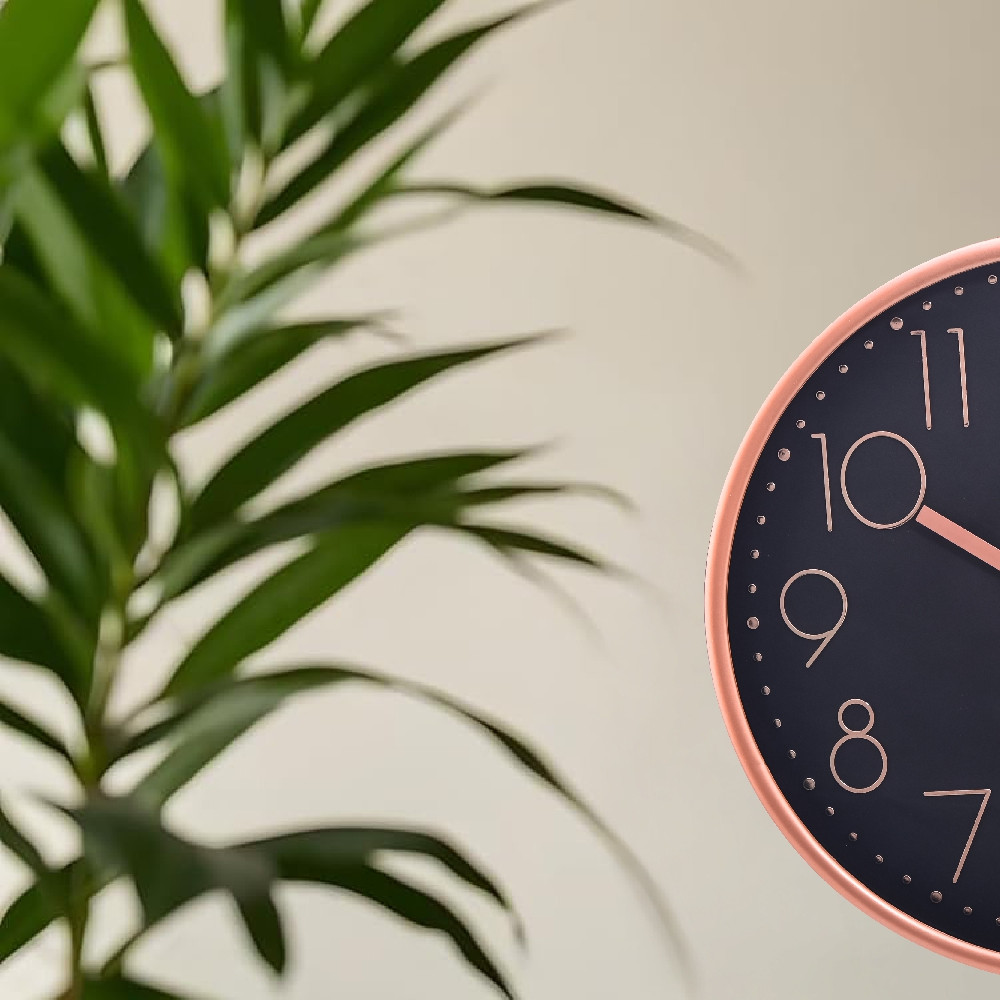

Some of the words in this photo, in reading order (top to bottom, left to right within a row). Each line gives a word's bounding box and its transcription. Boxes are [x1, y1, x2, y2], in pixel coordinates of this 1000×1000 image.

[911, 327, 970, 430] 11
[811, 430, 927, 532] 10
[780, 568, 848, 668] 9
[829, 699, 888, 793] 8
[924, 789, 991, 884] 7
